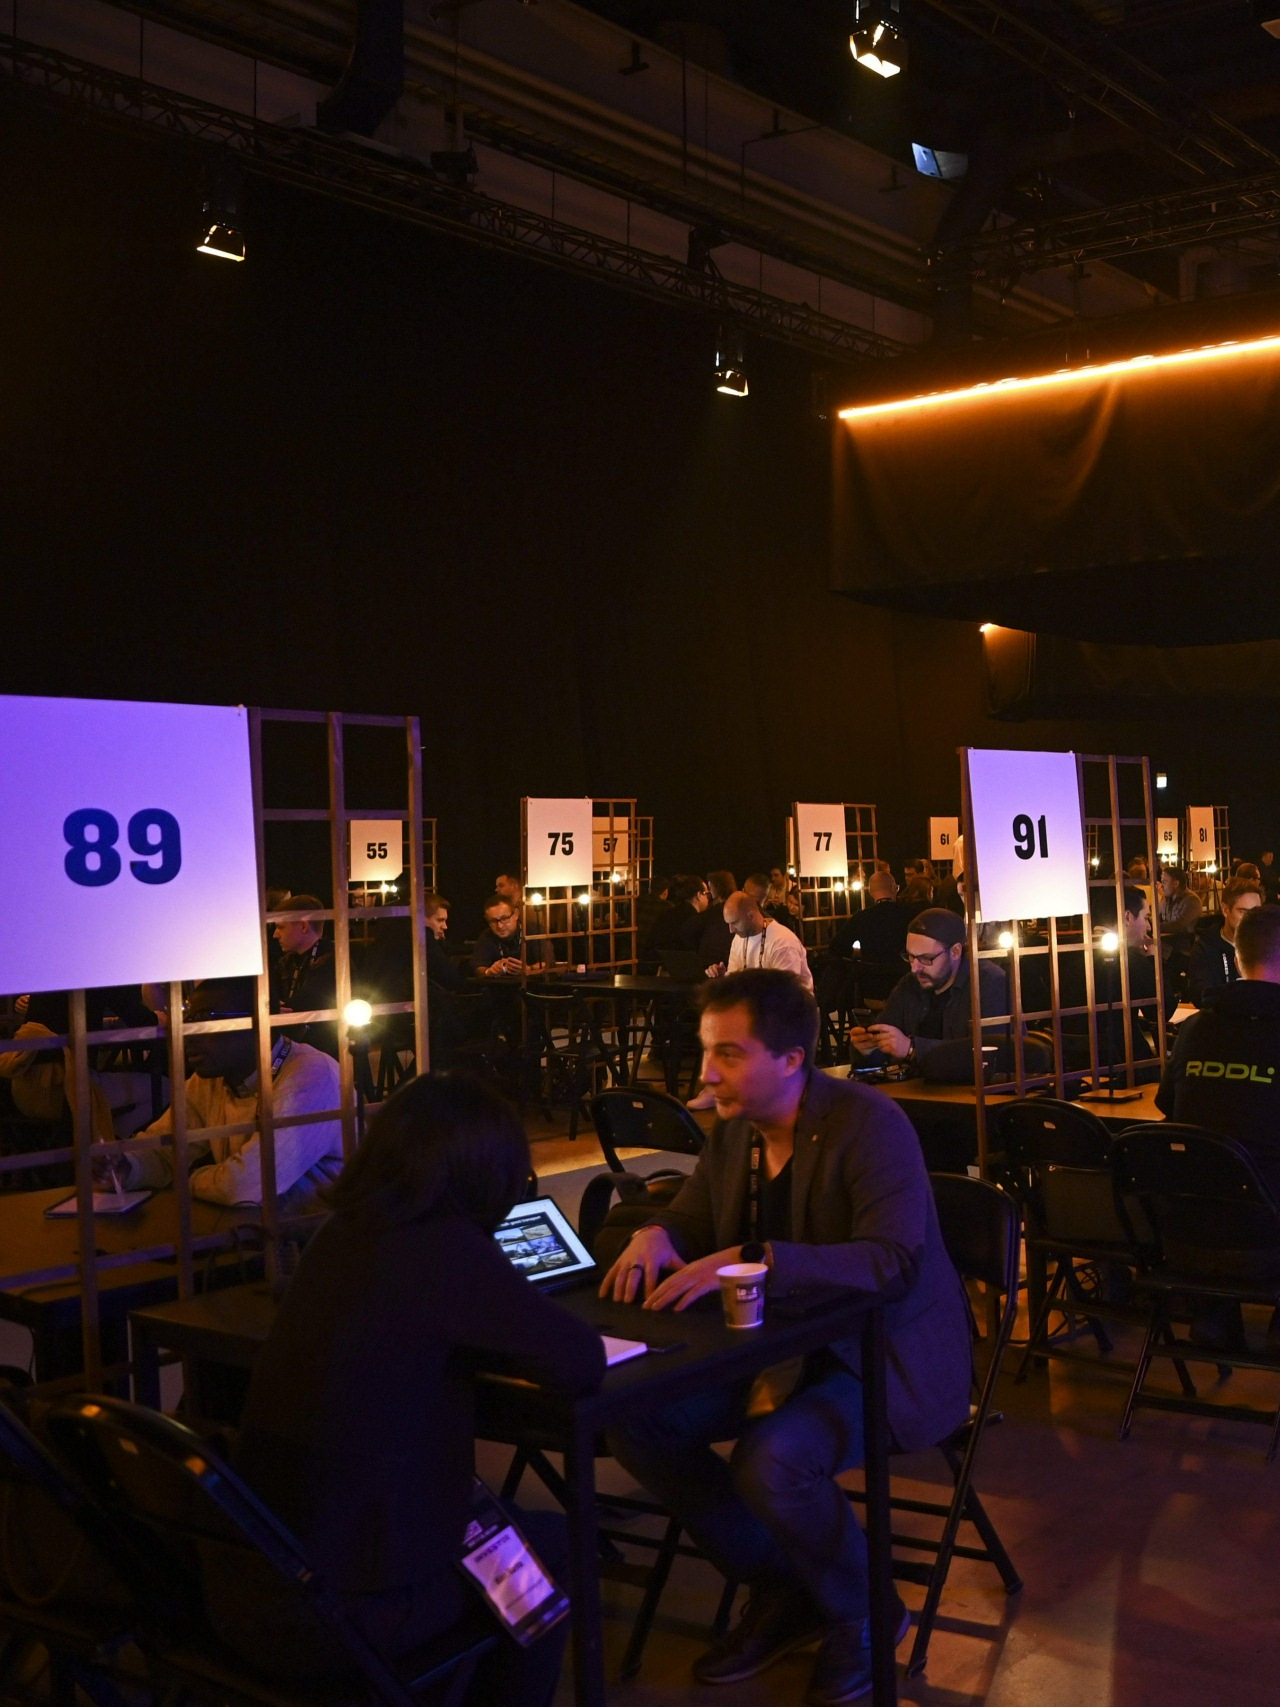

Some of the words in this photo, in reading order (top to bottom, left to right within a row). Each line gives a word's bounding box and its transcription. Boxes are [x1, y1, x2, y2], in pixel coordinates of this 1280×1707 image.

[547, 832, 574, 856] 75
[813, 832, 833, 851] 77
[940, 833, 950, 845] 61
[1012, 814, 1049, 860] 91
[1163, 831, 1173, 842] 65
[1199, 827, 1208, 843] 81
[63, 808, 182, 887] 89
[366, 842, 388, 860] 55
[603, 837, 618, 853] 57
